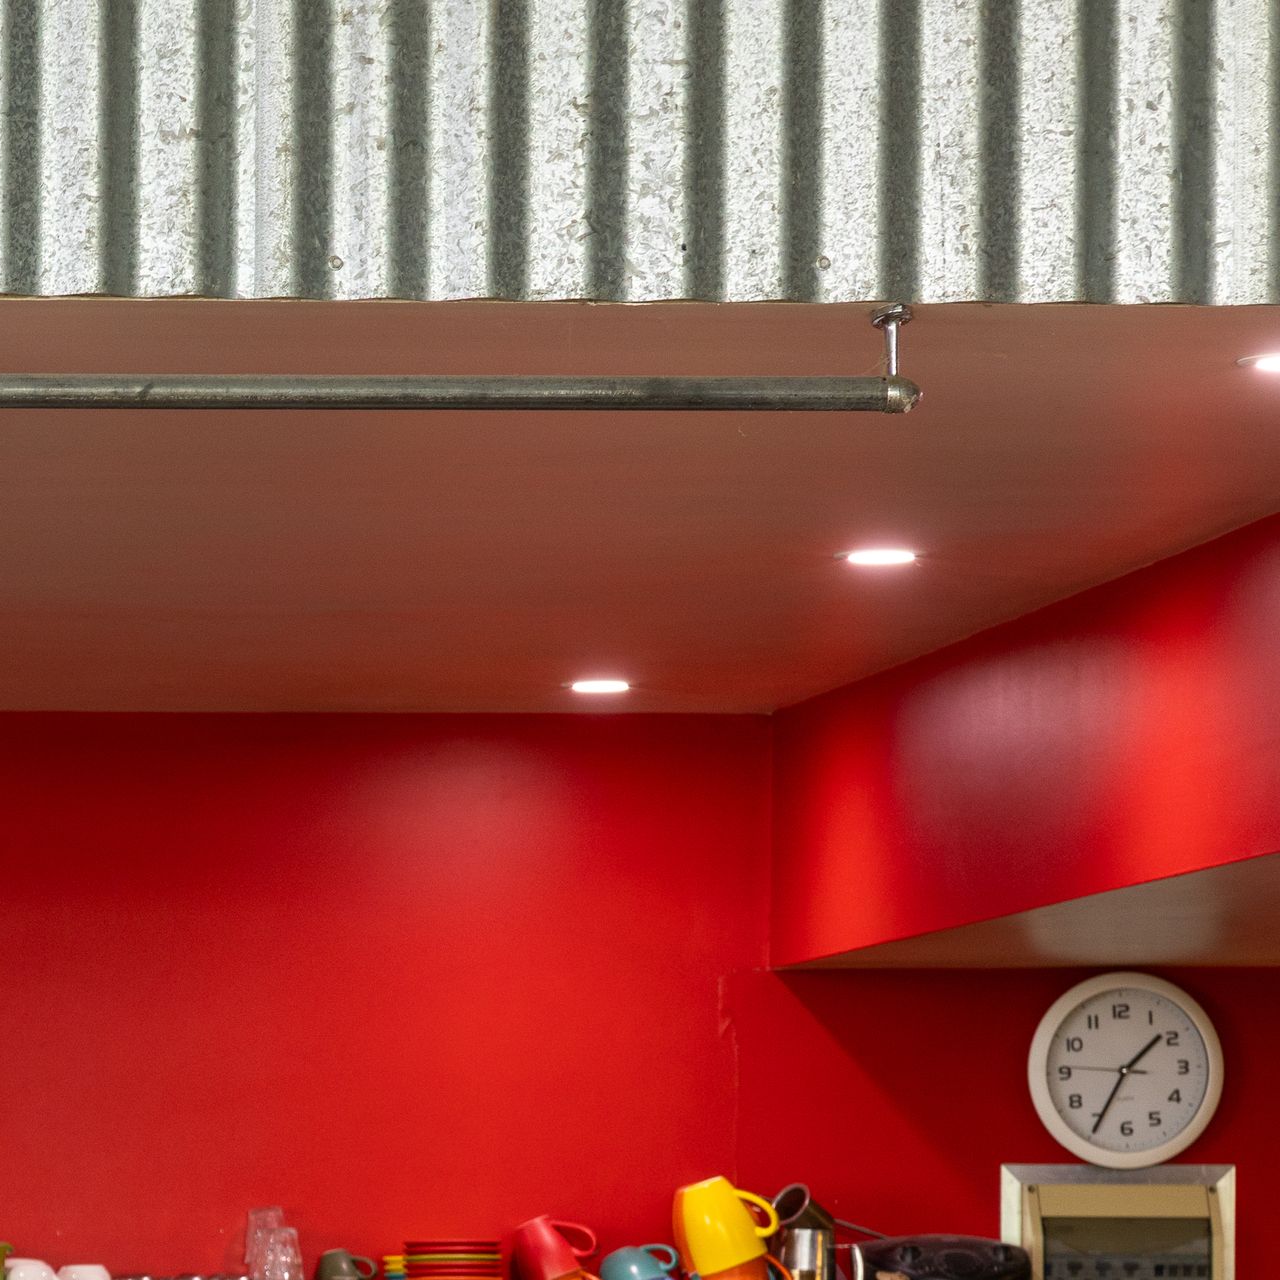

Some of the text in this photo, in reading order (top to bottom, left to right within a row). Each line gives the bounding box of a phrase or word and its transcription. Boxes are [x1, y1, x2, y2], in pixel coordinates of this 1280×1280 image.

[1112, 1004, 1130, 1019] 12
[1148, 1011, 1153, 1025] 1
[1088, 1015, 1099, 1029] 11
[1066, 1038, 1083, 1052] 10
[1166, 1031, 1179, 1046] 2
[1059, 1065, 1072, 1080] 9
[1178, 1060, 1189, 1075] 3
[1069, 1094, 1082, 1109] 8
[1168, 1088, 1182, 1103] 4
[1149, 1112, 1161, 1126] 5
[1120, 1121, 1133, 1136] 6
